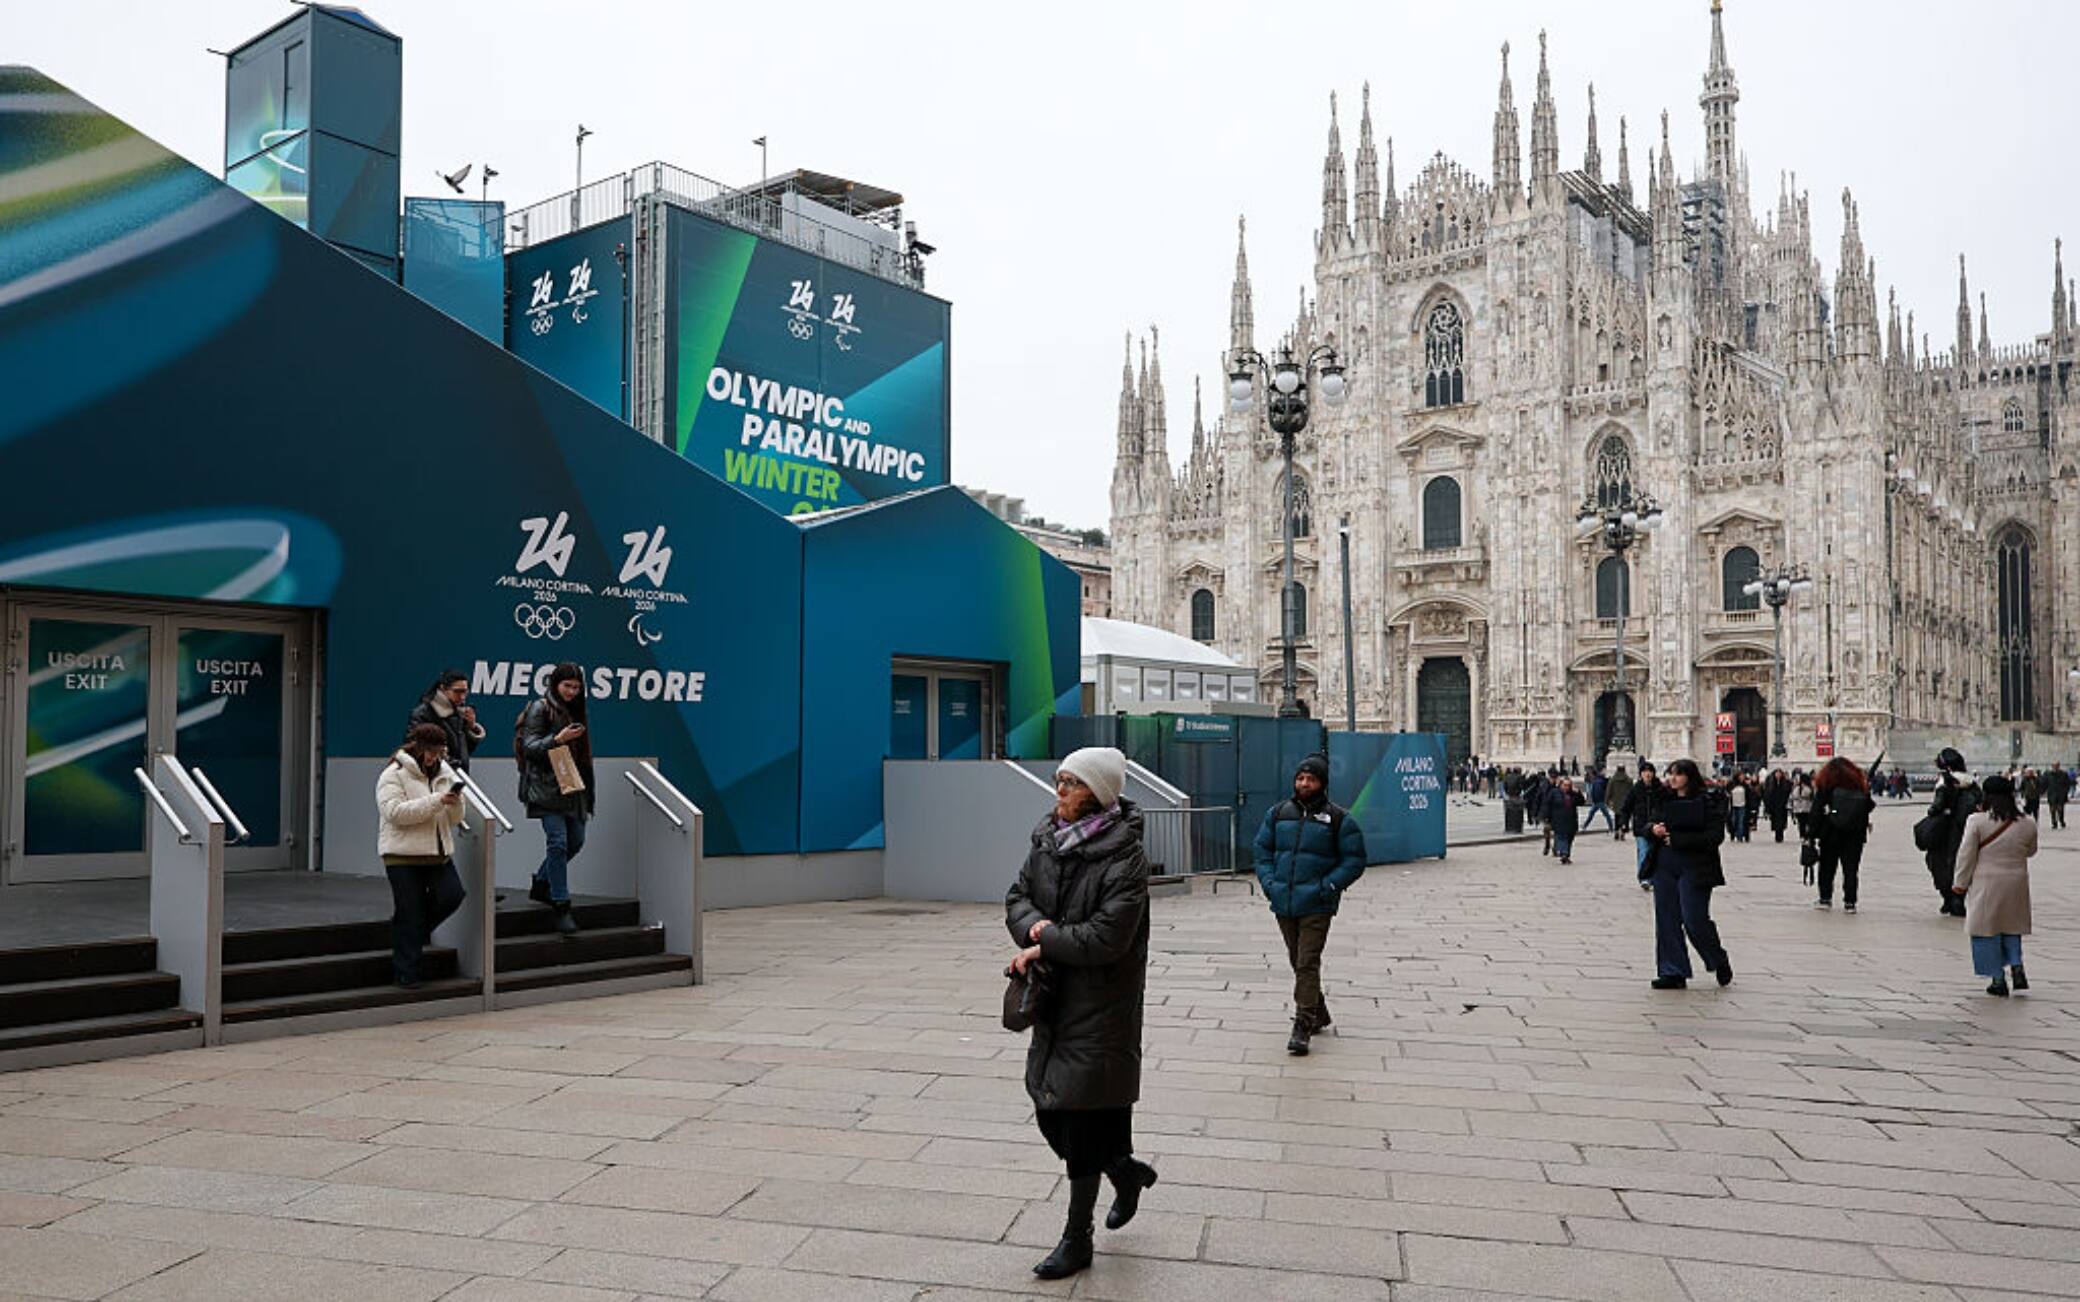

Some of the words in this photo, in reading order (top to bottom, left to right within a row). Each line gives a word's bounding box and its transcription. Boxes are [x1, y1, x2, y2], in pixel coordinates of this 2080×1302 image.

[706, 366, 845, 428] OLYMPIC
[844, 418, 870, 435] AND
[741, 413, 925, 482] PARALYMPIC
[724, 448, 841, 501] WINTER
[495, 575, 545, 589] MILANO
[546, 580, 593, 594] CORTINA
[533, 590, 557, 602] 2026
[601, 586, 645, 600] MILANO
[645, 590, 688, 603] CORTINA
[48, 651, 126, 671] USCITA
[196, 659, 263, 677] USCITA
[65, 674, 109, 690] EXIT
[211, 680, 249, 695] EXIT
[1394, 757, 1434, 773] MILANO
[1402, 775, 1441, 791] CORTINA
[1409, 793, 1429, 809] 2026
